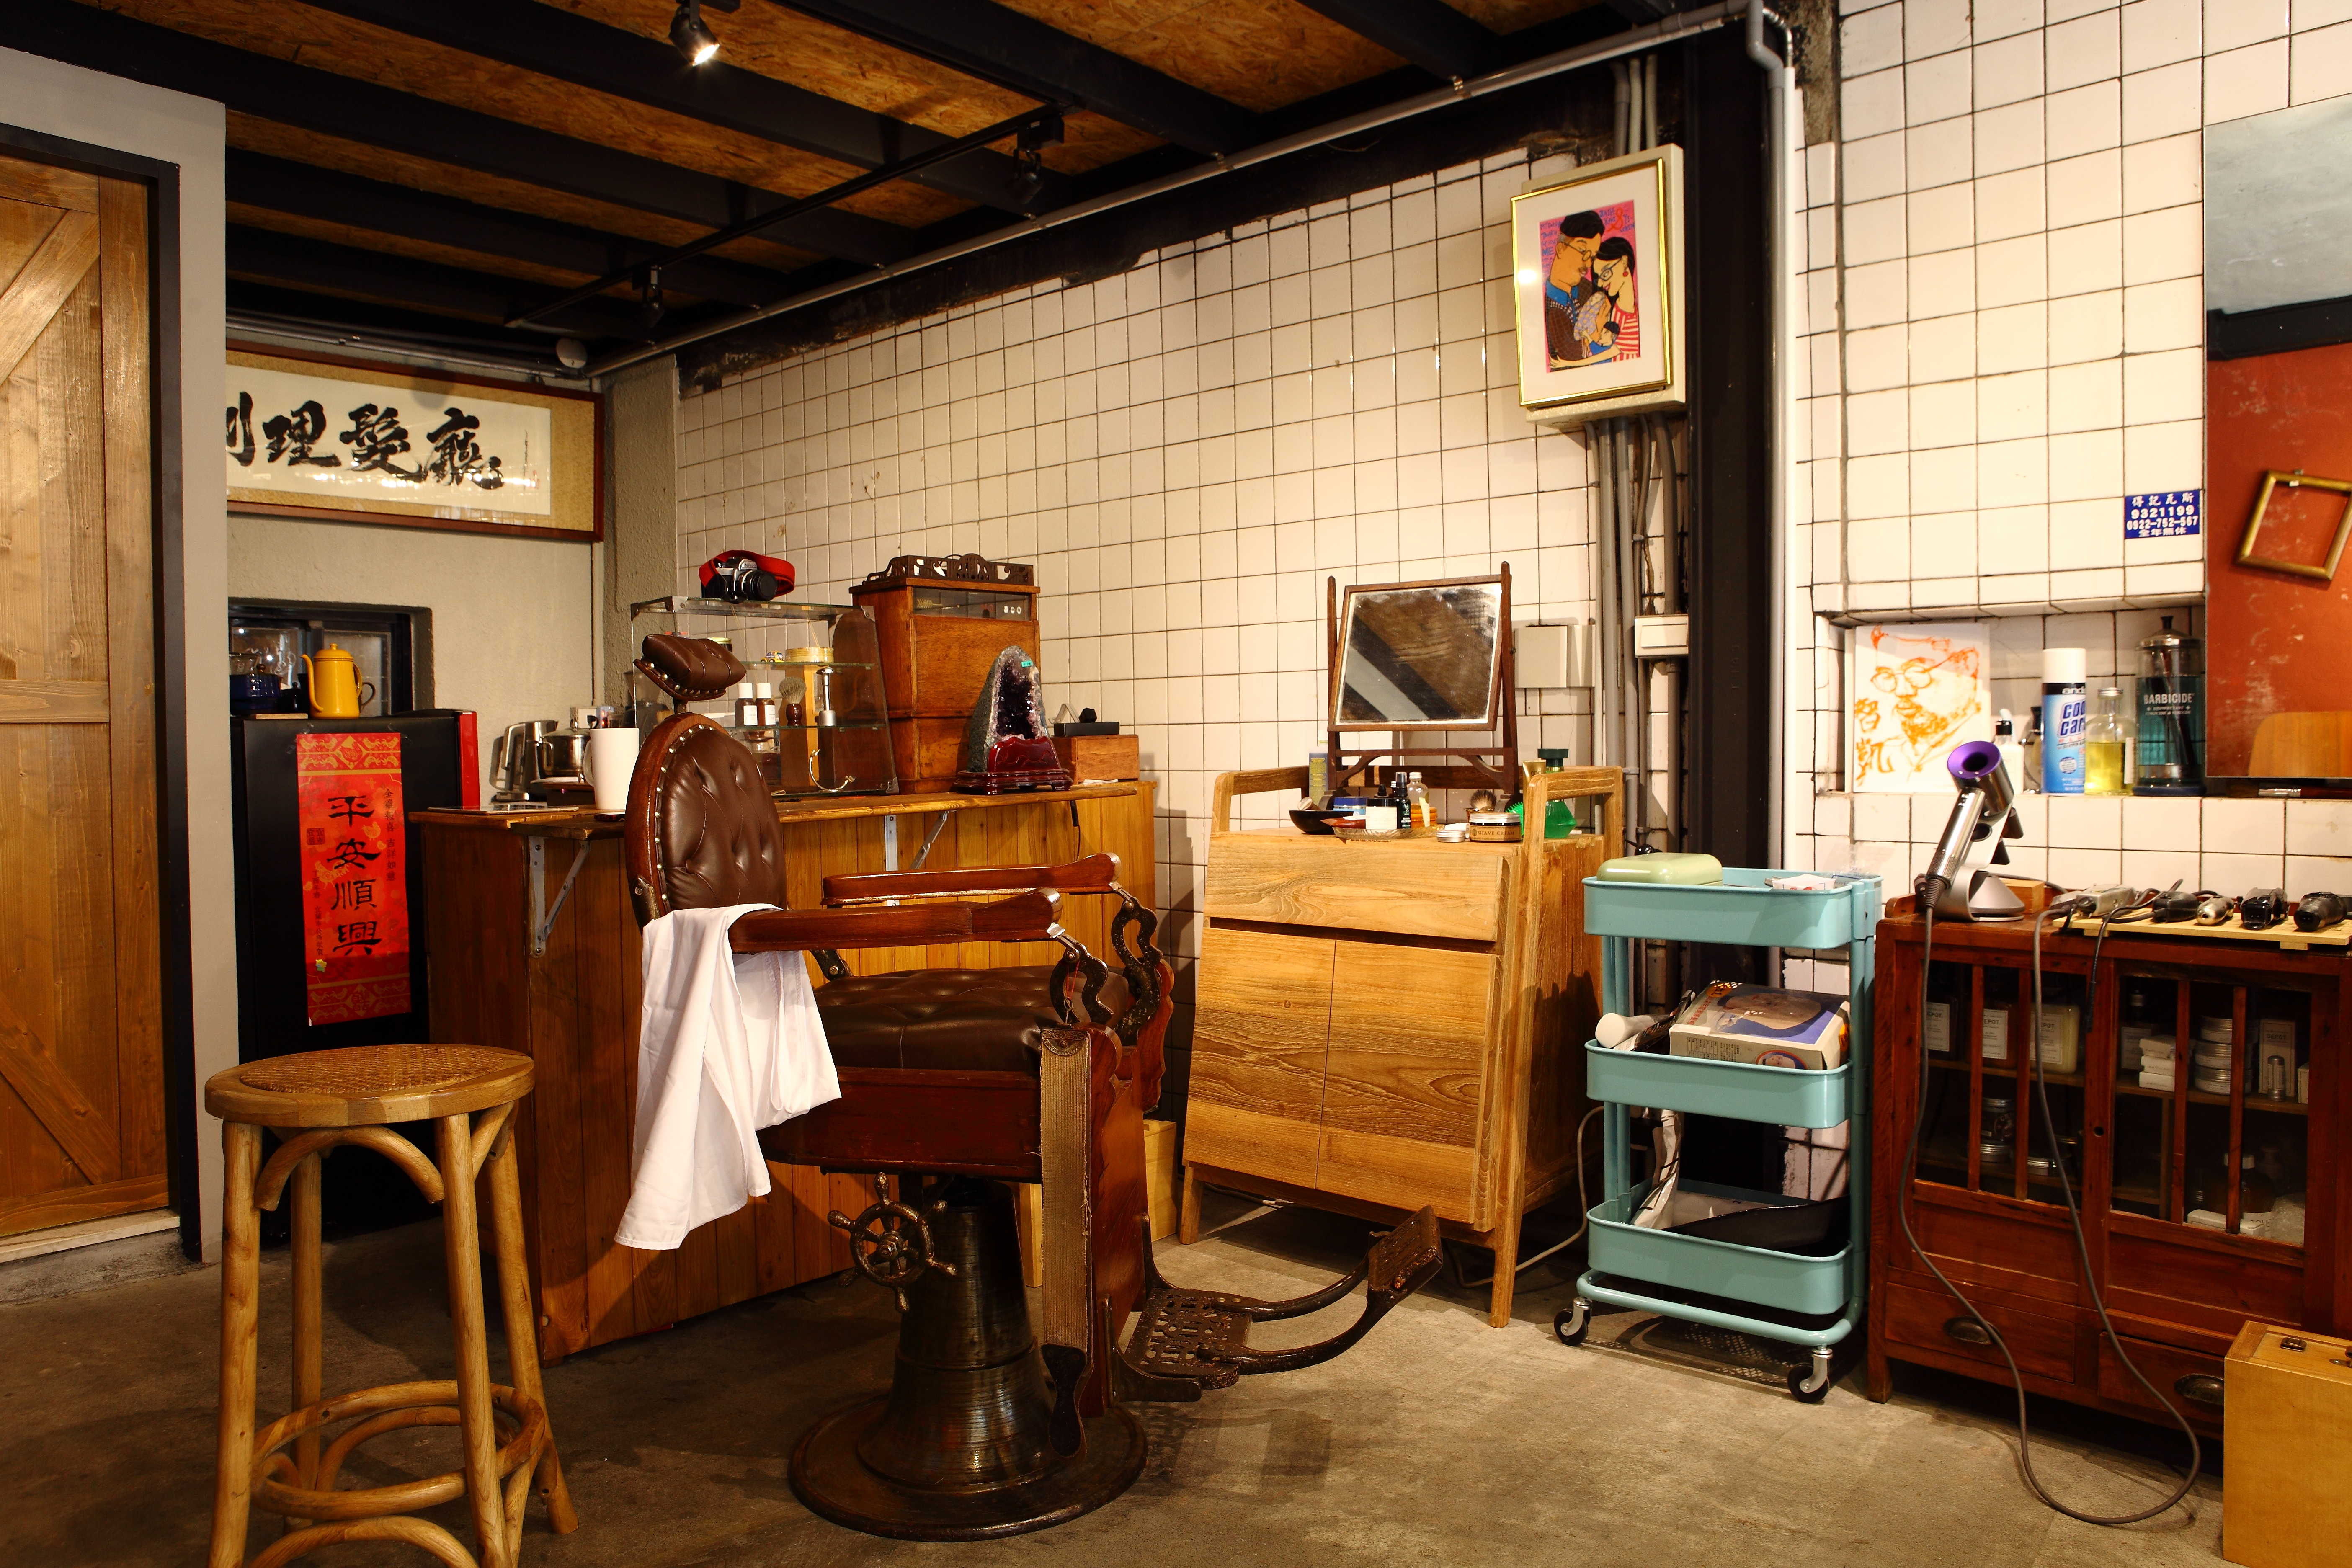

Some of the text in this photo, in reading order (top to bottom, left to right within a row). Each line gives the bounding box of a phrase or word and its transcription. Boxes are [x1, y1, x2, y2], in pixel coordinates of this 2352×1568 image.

[2131, 505, 2195, 519] 9321199
[2127, 515, 2198, 530] 0922-752-567
[2144, 693, 2193, 704] BARBICIDE
[386, 838, 396, 882] 吉祥如意
[327, 795, 383, 956] 平安順興
